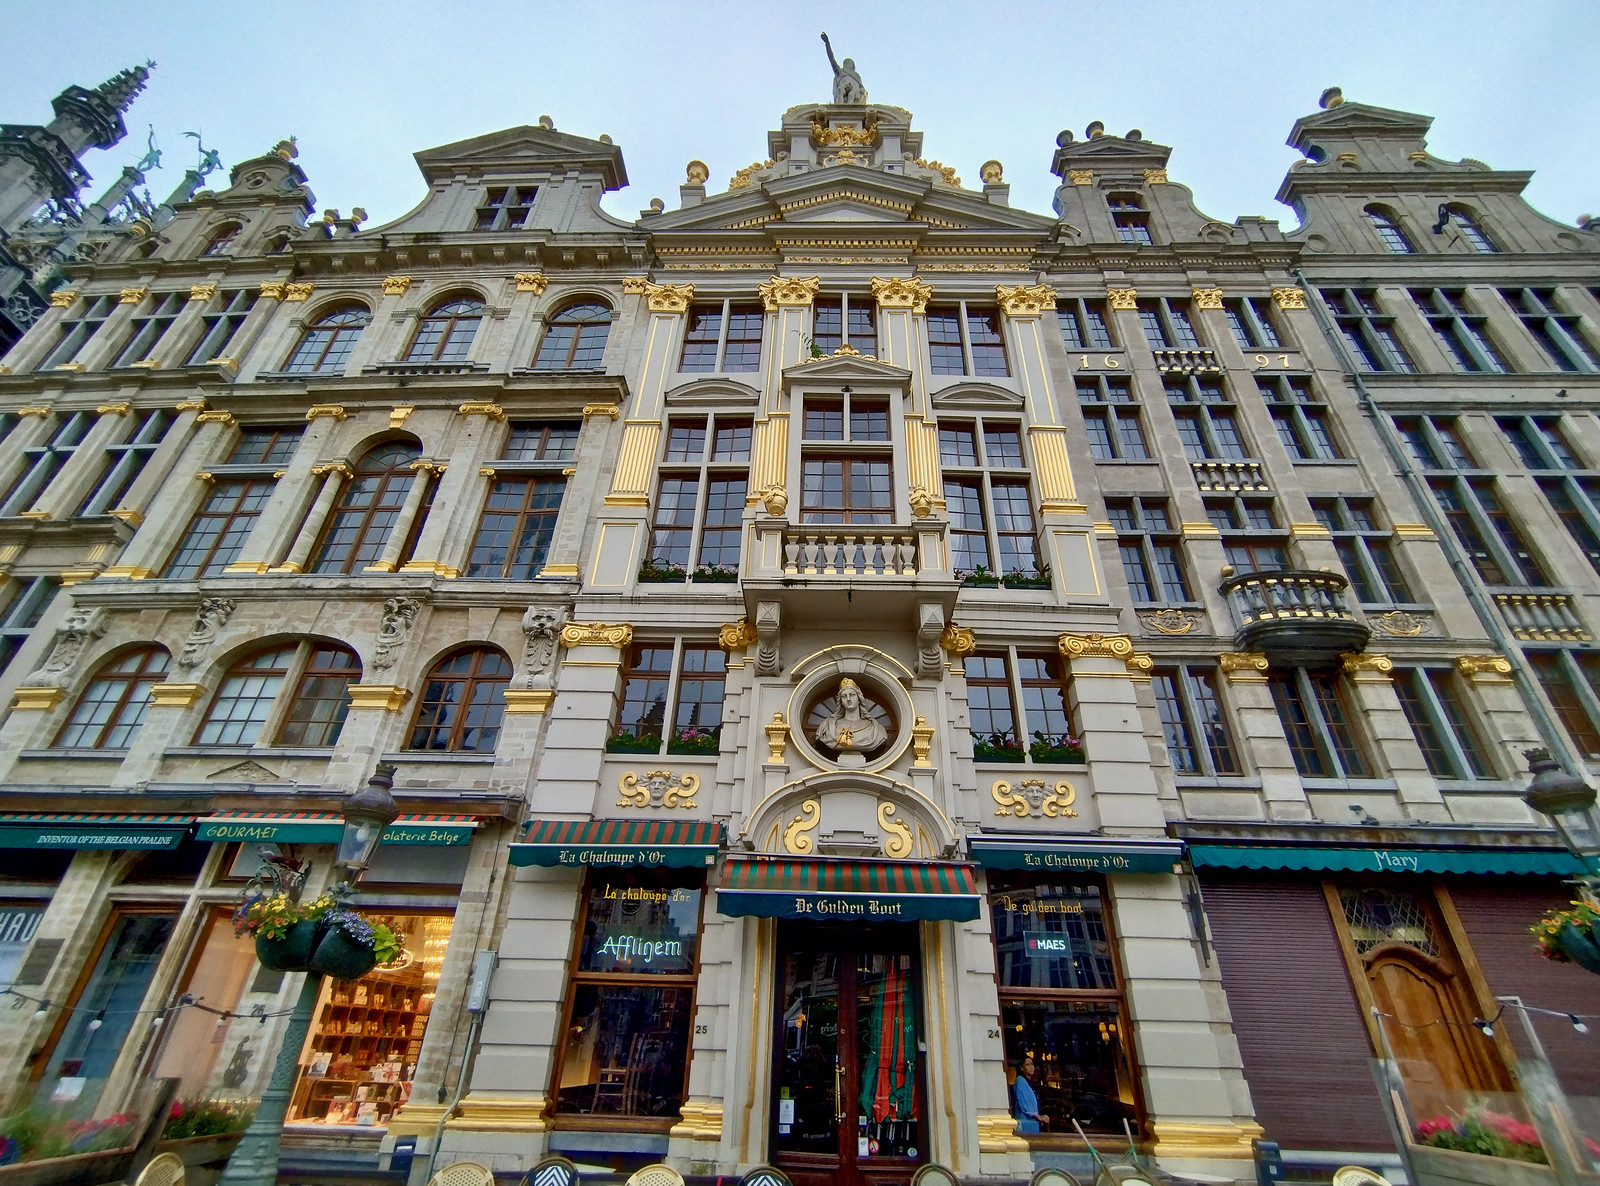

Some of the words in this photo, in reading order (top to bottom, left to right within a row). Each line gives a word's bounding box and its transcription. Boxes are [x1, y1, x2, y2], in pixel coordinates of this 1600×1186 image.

[37, 835, 78, 844] INVENTOR
[78, 836, 89, 844] OF
[88, 836, 106, 845] THE
[104, 836, 140, 845] BELGIAN
[138, 837, 173, 845] PRALINE
[206, 825, 279, 839] GOURMET
[383, 830, 426, 841] olaterie
[428, 830, 459, 845] Belge
[559, 850, 576, 863] La
[579, 850, 635, 866] Chaloupe
[638, 850, 666, 863] d'Or
[1024, 853, 1041, 866] La
[1044, 853, 1100, 869] Chaloupe
[1102, 855, 1130, 868] d'Or
[1373, 851, 1418, 871] Mary
[603, 883, 617, 899] La
[621, 887, 667, 903] chaloupe
[795, 898, 813, 913] De
[816, 899, 864, 914] Gulden
[868, 900, 902, 915] Boot
[1002, 895, 1018, 911] De
[1022, 900, 1057, 915] gulden
[1059, 900, 1083, 913] boot
[597, 935, 681, 963] Affligem
[1037, 939, 1066, 950] MAES
[695, 1025, 708, 1034] 25
[987, 1029, 1000, 1039] 24
